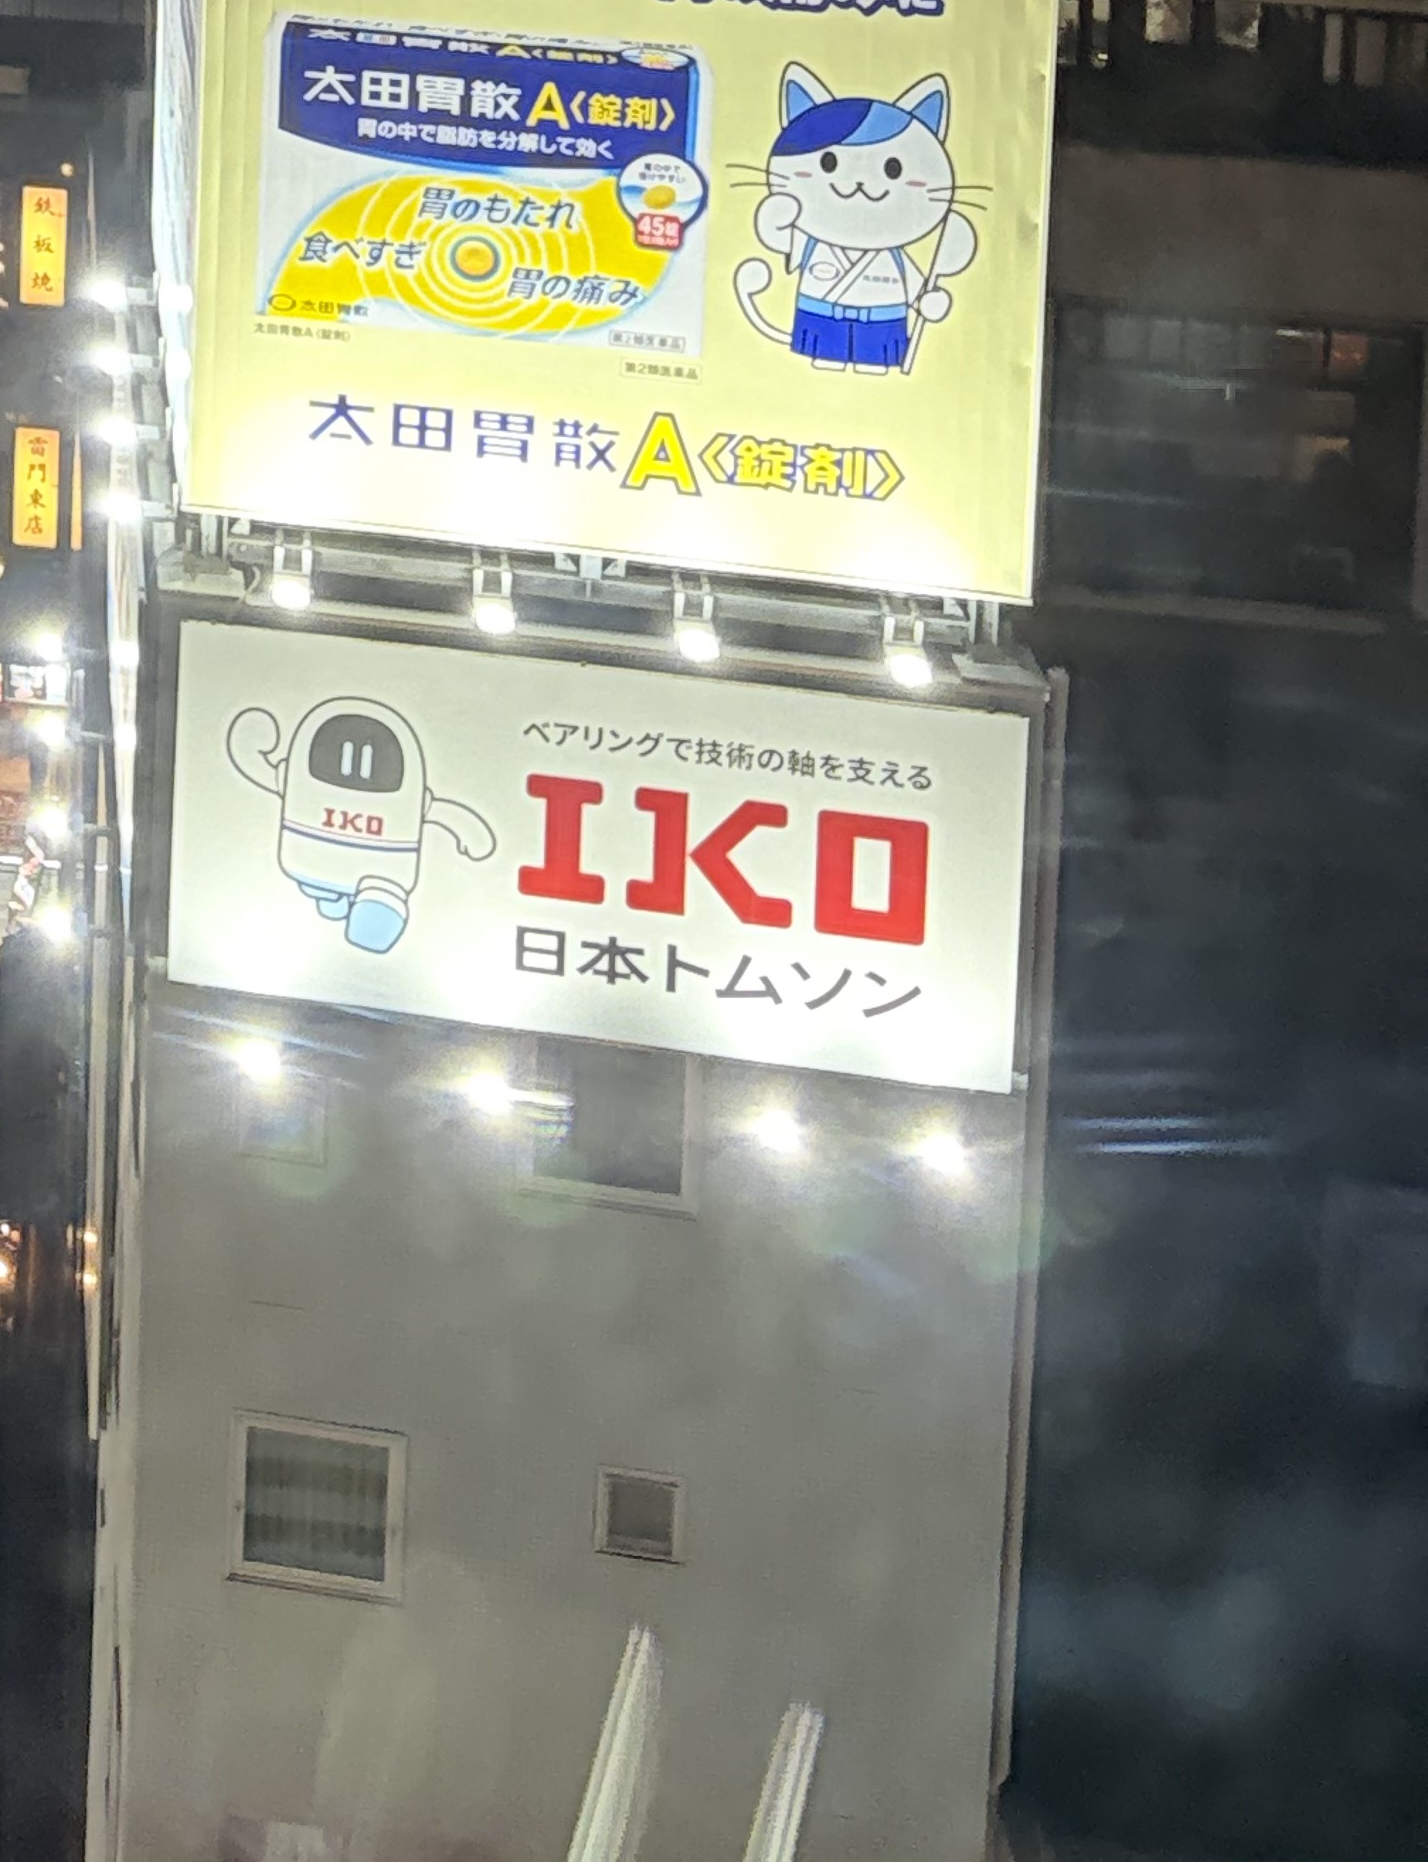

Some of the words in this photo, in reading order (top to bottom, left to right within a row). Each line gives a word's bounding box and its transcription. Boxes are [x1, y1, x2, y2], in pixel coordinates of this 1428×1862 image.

[417, 185, 576, 231] 胃のもたれ
[297, 230, 428, 270] 食べすぎ
[506, 267, 641, 307] 胃の痛み
[24, 437, 51, 536] 雷門東店
[521, 719, 934, 792] ベアリングで技術の軸を支える
[321, 806, 384, 837] IKO
[515, 772, 931, 947] IKO
[512, 924, 924, 1019] 日本トムソン
